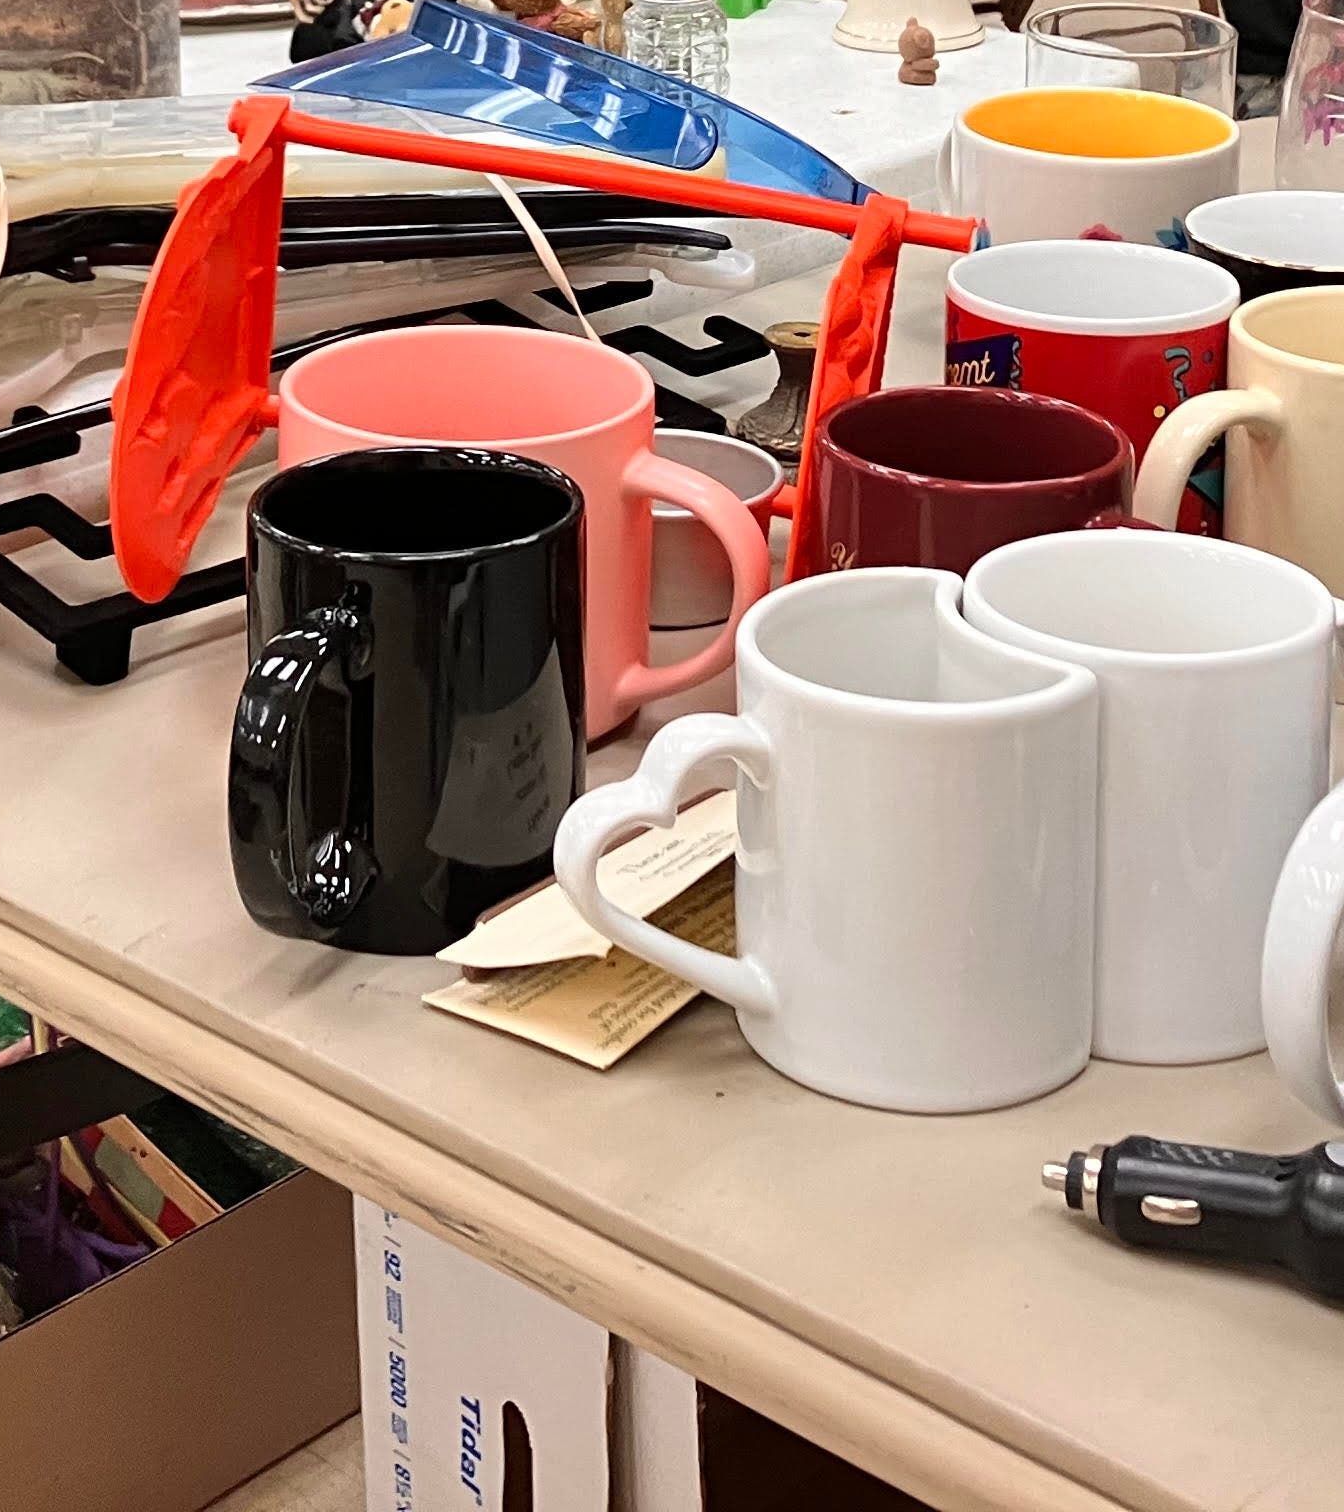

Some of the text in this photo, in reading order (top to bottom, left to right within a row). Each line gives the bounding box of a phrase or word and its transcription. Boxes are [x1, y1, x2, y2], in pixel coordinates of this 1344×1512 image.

[383, 1250, 402, 1282] 92
[389, 1351, 408, 1408] 5000
[460, 1395, 482, 1497] Tidal
